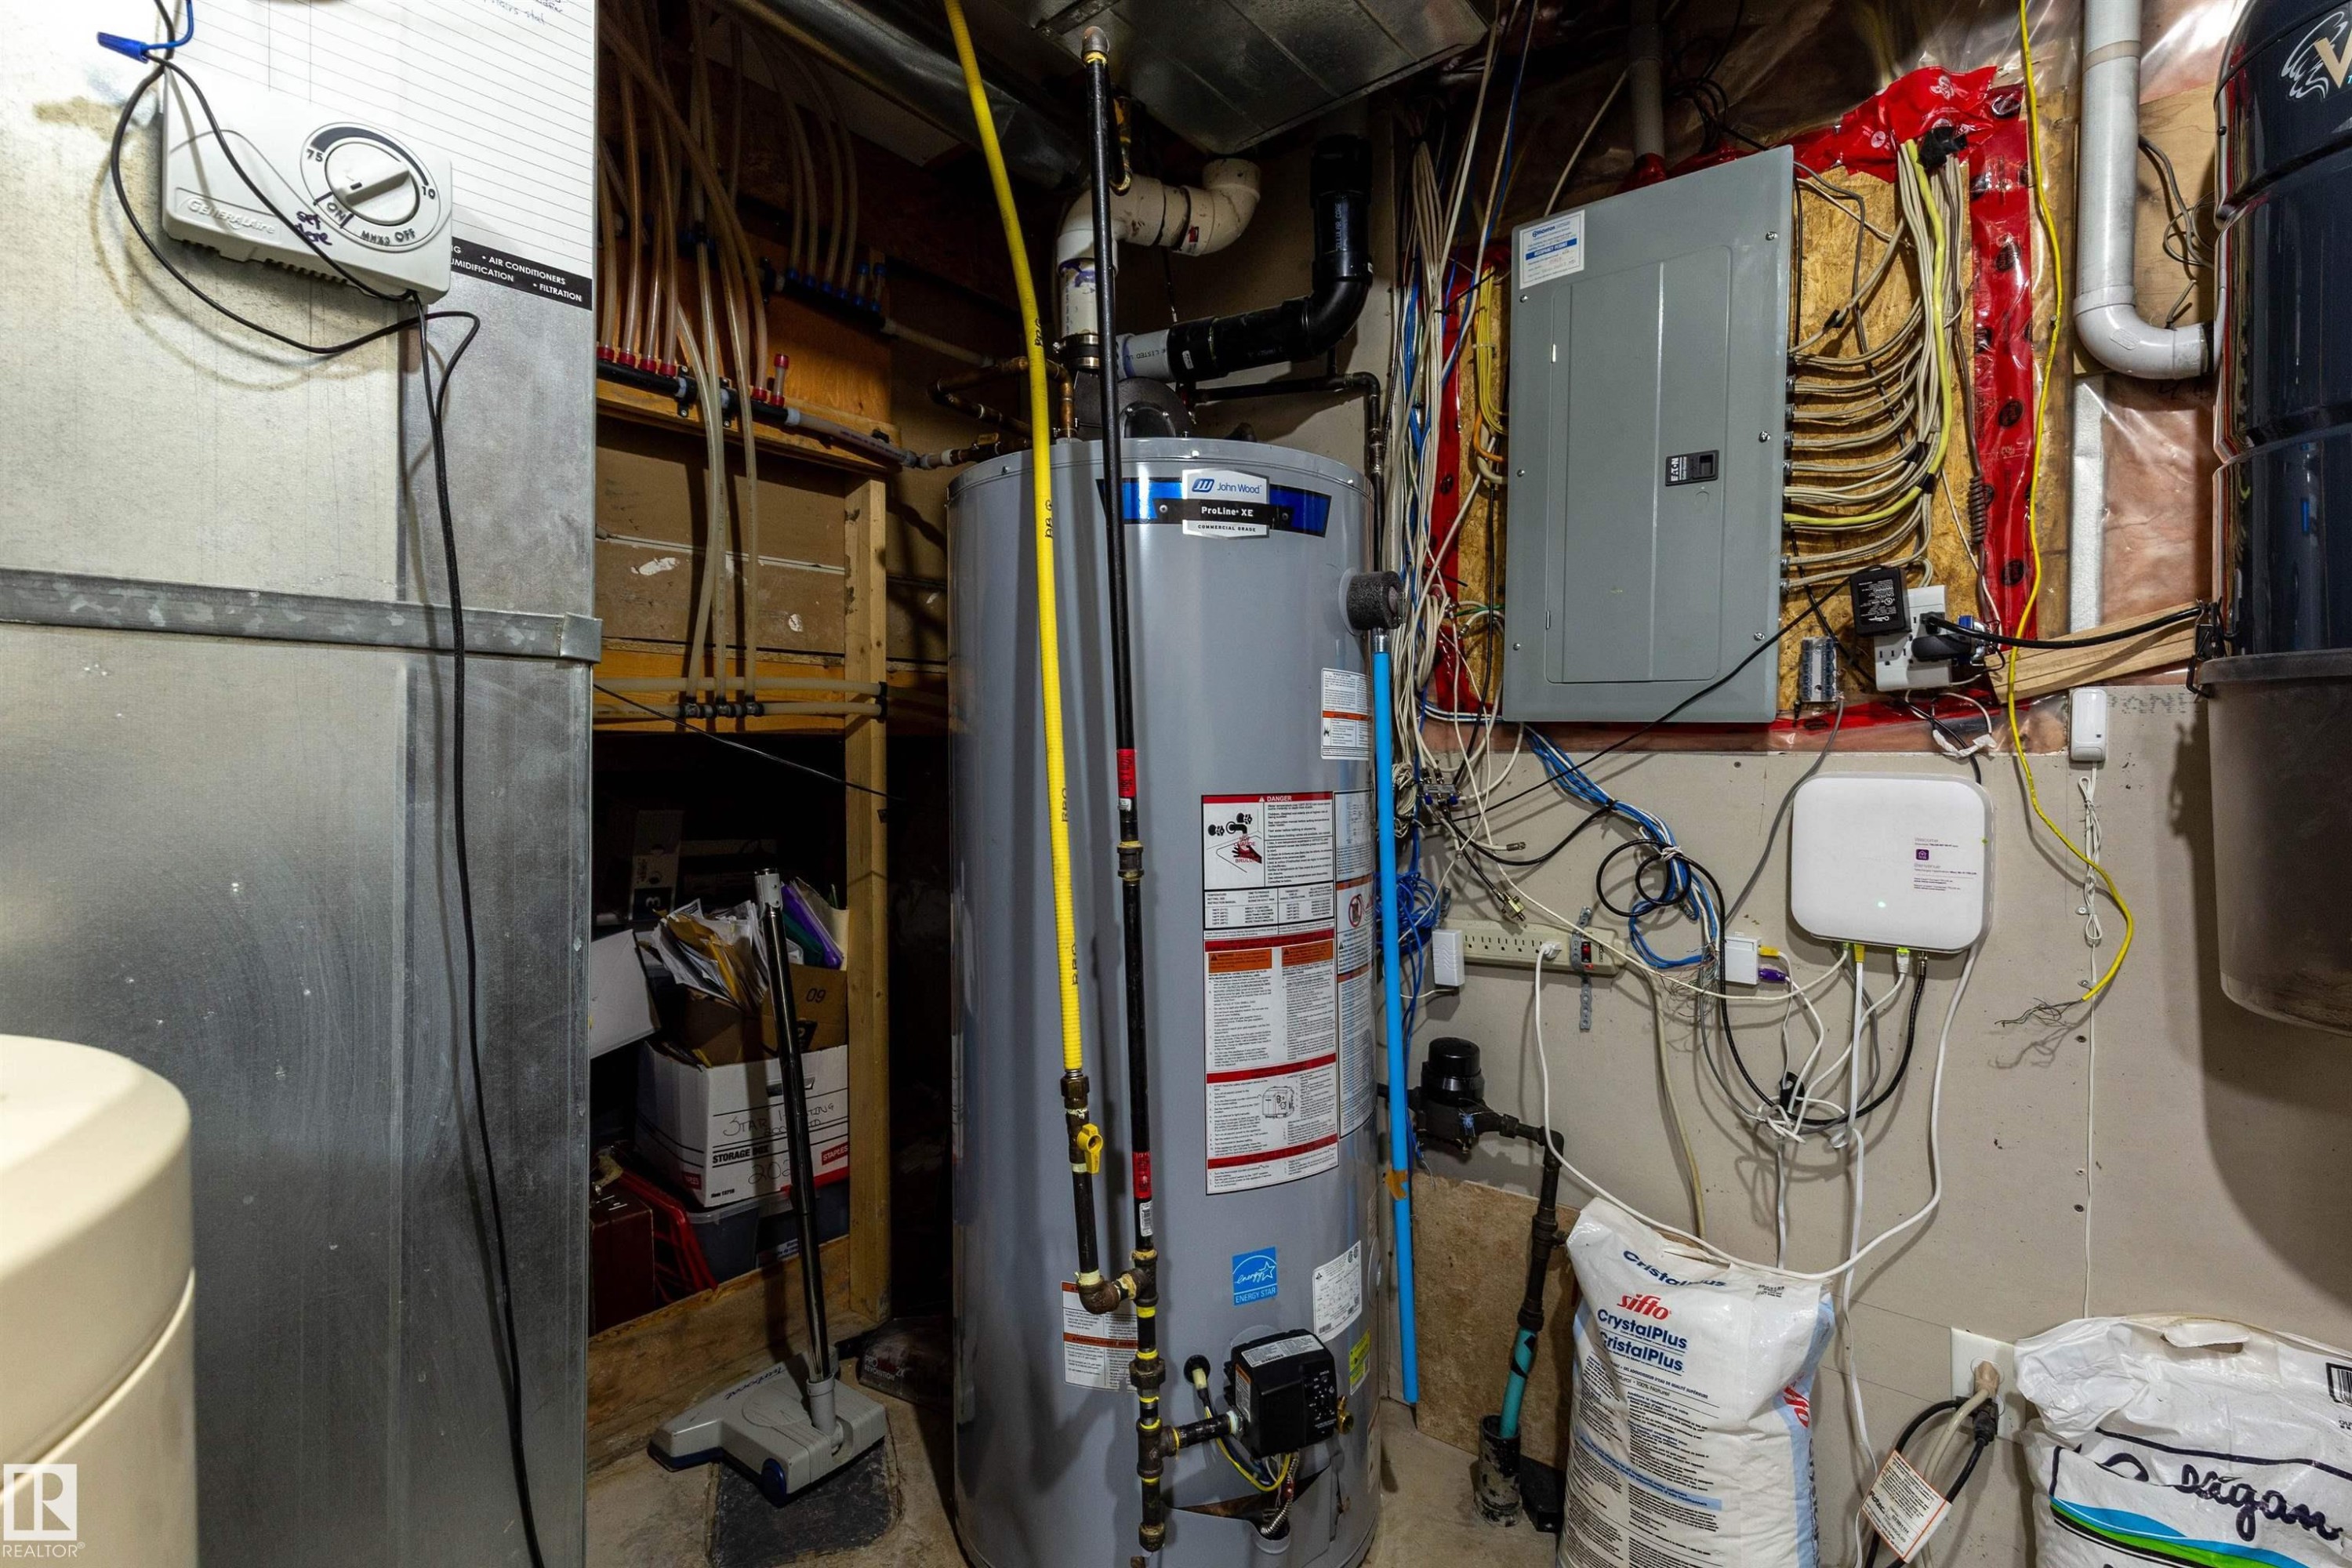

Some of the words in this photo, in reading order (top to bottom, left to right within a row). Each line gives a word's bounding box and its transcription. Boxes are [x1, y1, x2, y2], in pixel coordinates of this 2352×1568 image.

[306, 149, 323, 163] 75
[421, 185, 436, 199] 10
[326, 201, 347, 222] ON
[394, 228, 416, 243] OFF
[488, 256, 503, 267] AIR
[505, 261, 566, 285] CONDITIONERS
[539, 283, 583, 303] FILTRATION
[1671, 457, 1679, 481] EATON
[1217, 482, 1236, 492] John
[1238, 484, 1260, 494] Wood
[1240, 508, 1254, 517] XE
[805, 988, 826, 1004] 09
[712, 1149, 751, 1164] STORAGE
[752, 1144, 770, 1156] BOX
[822, 1144, 849, 1162] STAPLES
[1235, 1290, 1260, 1304] ENERGY
[1260, 1287, 1276, 1298] STAR
[1616, 1294, 1670, 1320] sifto
[1597, 1308, 1688, 1349] CrystalPlus
[1616, 1374, 1632, 1384] atural
